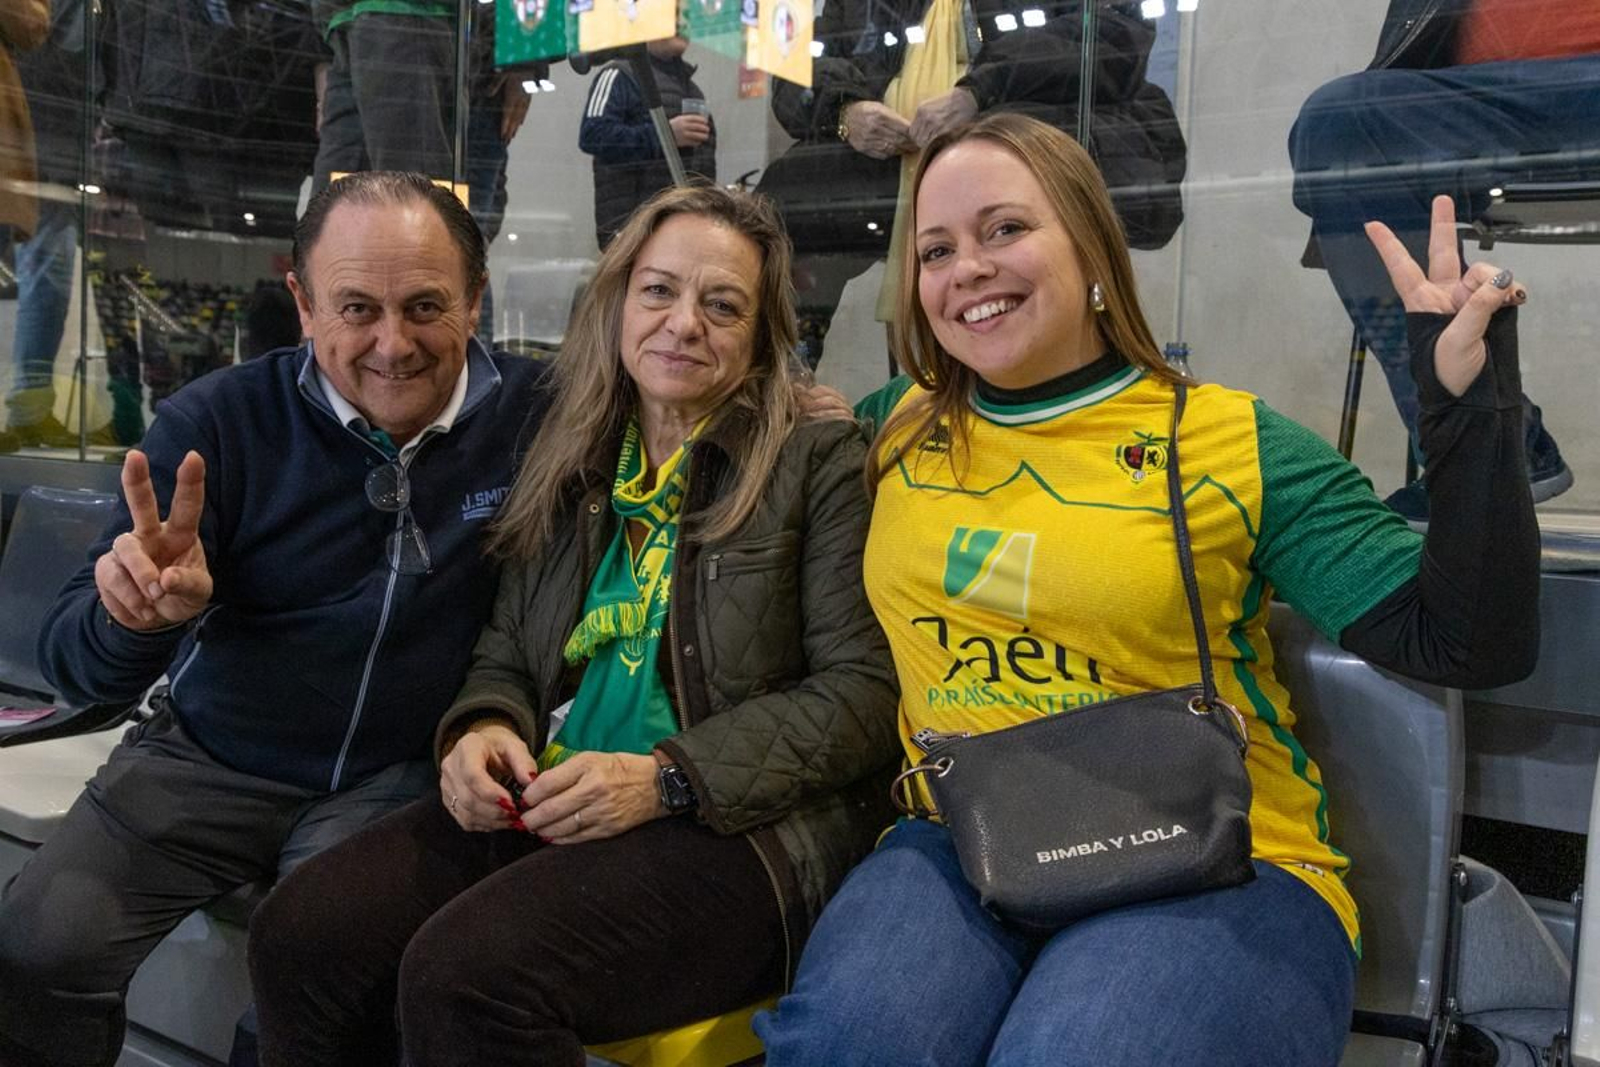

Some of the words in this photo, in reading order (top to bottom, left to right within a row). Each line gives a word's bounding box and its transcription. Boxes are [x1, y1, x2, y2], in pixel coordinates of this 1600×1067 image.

[461, 486, 511, 511] J.SMIT
[1035, 840, 1108, 864] BIMBA
[1108, 836, 1124, 849] Y
[1129, 823, 1188, 846] LOLA
